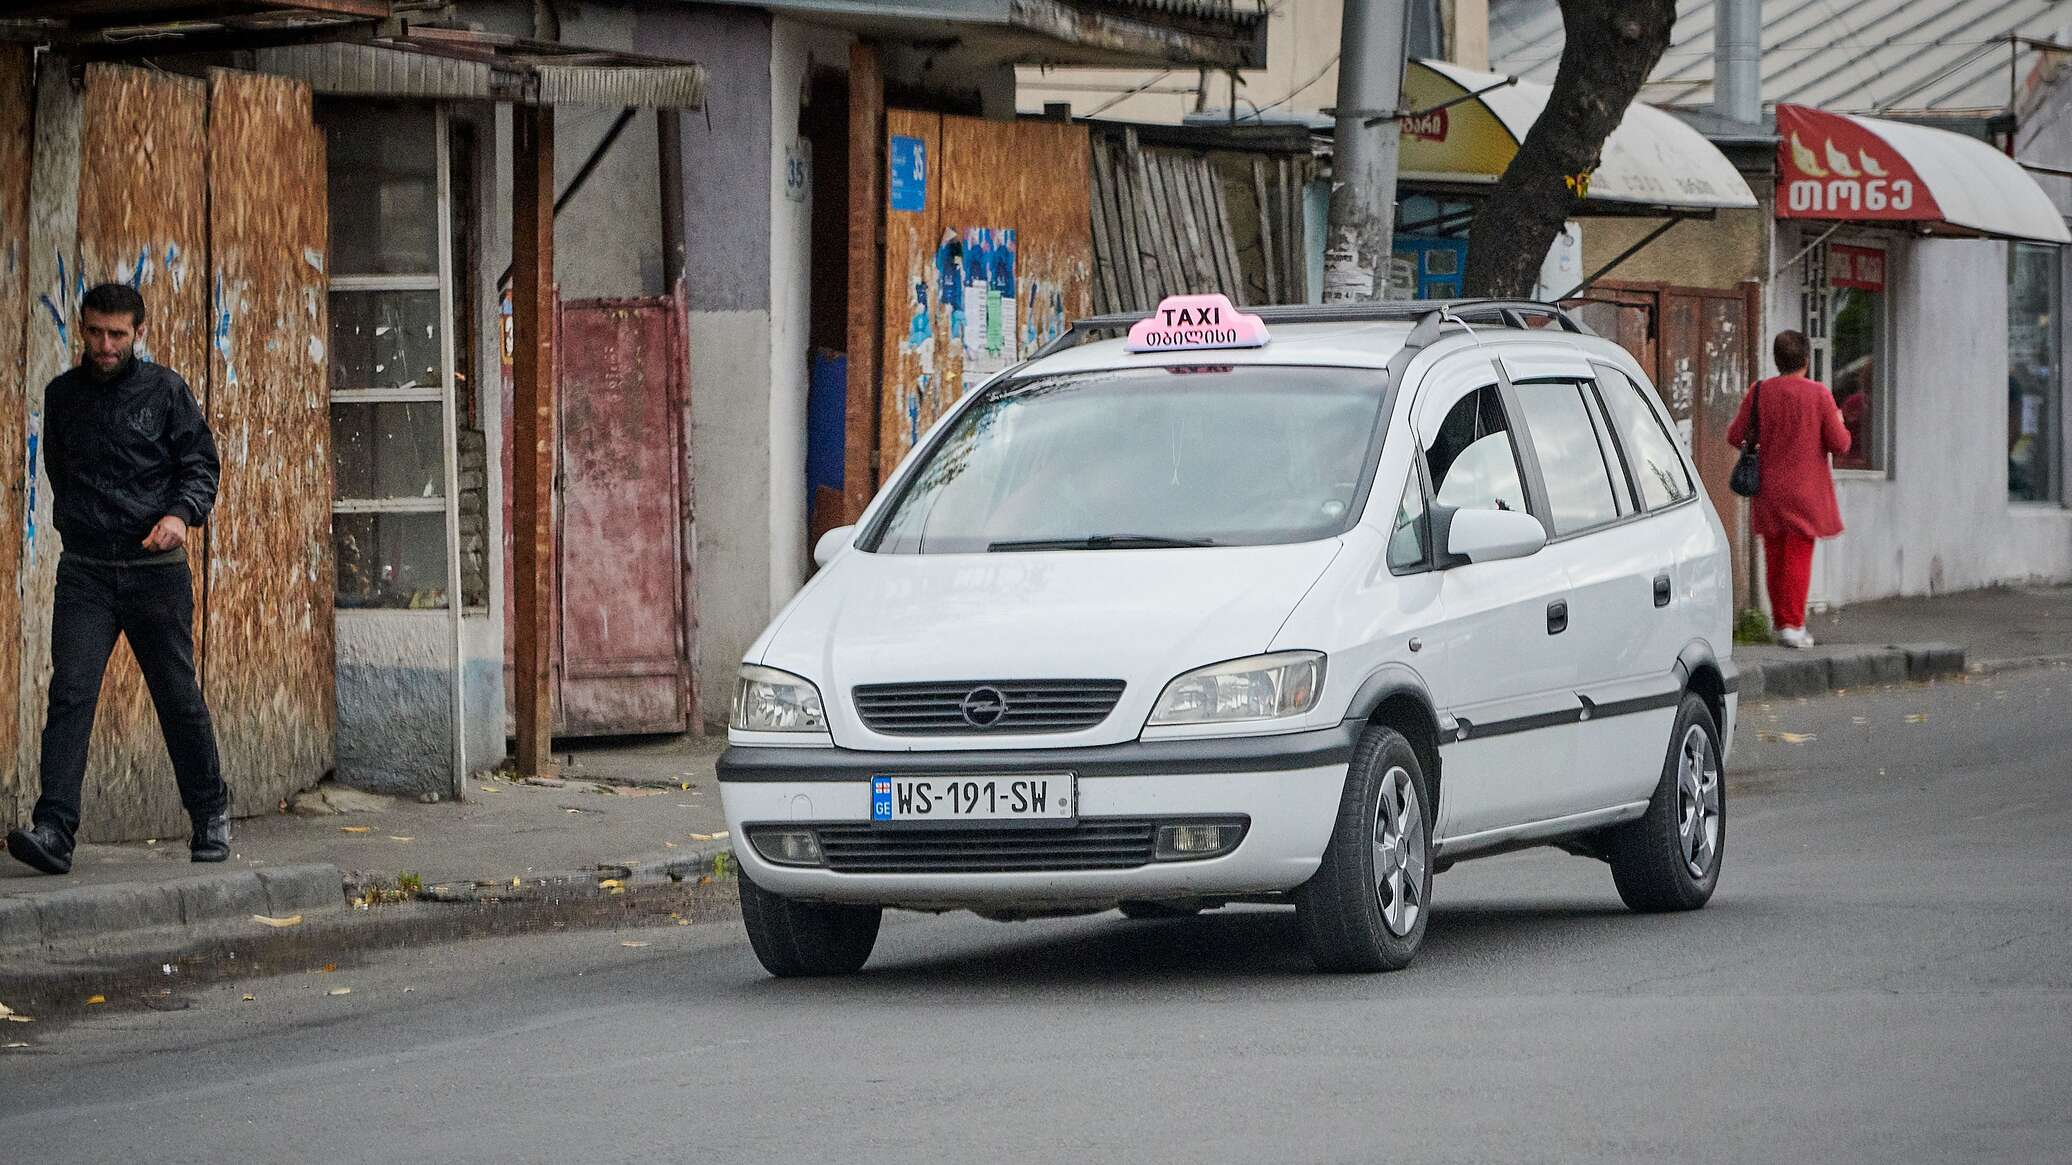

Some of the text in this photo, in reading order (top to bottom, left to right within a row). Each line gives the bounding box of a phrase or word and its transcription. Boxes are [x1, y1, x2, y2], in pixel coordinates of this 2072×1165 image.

[788, 158, 803, 189] 35
[1789, 179, 1913, 212] თონე
[1161, 307, 1220, 327] TAXI
[1146, 328, 1237, 347] თბილისი
[875, 802, 890, 815] GE
[897, 781, 1047, 814] WS-191-SW
